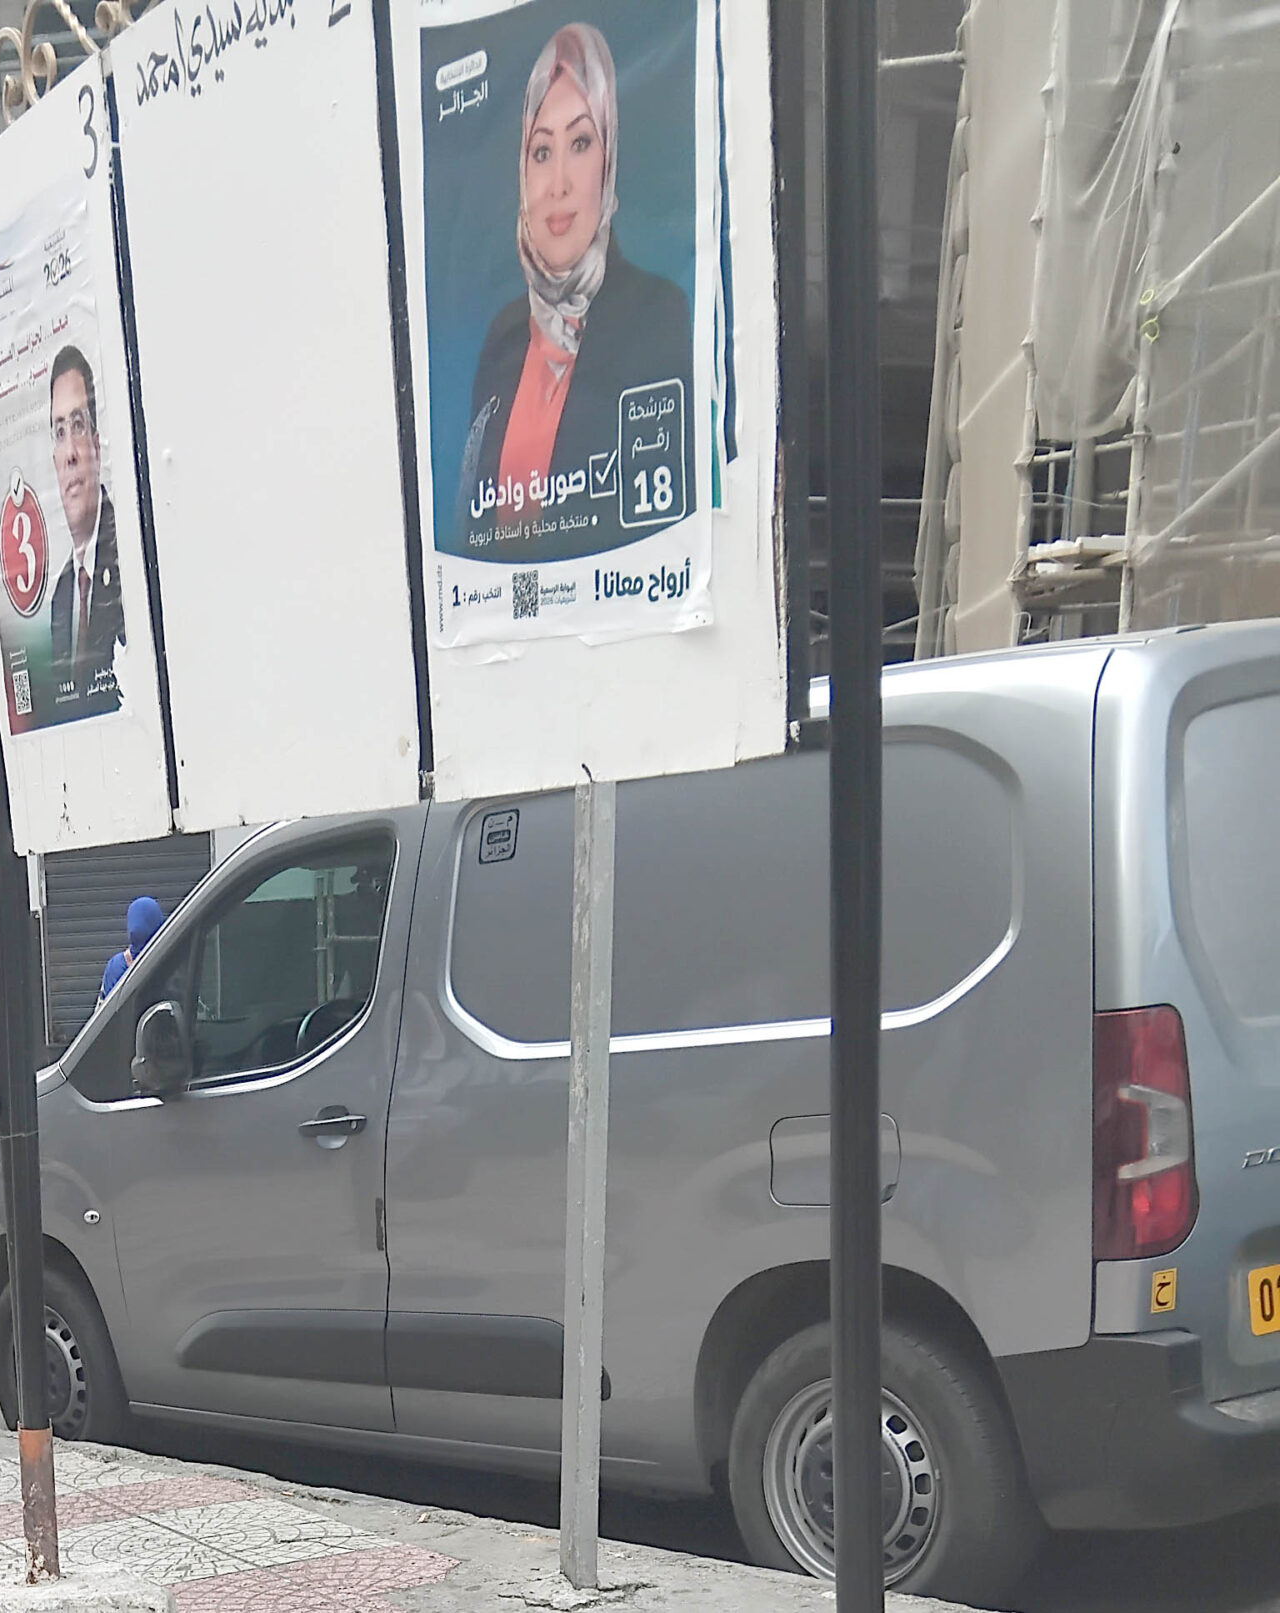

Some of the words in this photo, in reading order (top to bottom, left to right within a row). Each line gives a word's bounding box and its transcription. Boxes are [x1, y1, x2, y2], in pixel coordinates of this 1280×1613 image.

[438, 80, 488, 122] الجزائر
[78, 84, 98, 179] 3
[628, 396, 675, 421] مترشحة
[632, 427, 669, 459] رقم
[470, 475, 524, 518] وادفل
[528, 469, 586, 508] صورية
[634, 465, 673, 514] 18
[469, 528, 493, 547] تربوية
[524, 526, 530, 539] و
[532, 519, 557, 540] محلية
[559, 514, 589, 535] منتخبة
[12, 512, 36, 593] 3
[482, 586, 501, 603] انتخب
[648, 557, 691, 602] أرواح
[452, 585, 460, 607] 1
[468, 590, 480, 605] رقم
[1155, 1274, 1171, 1307] خ
[1259, 1274, 1280, 1323] 0
